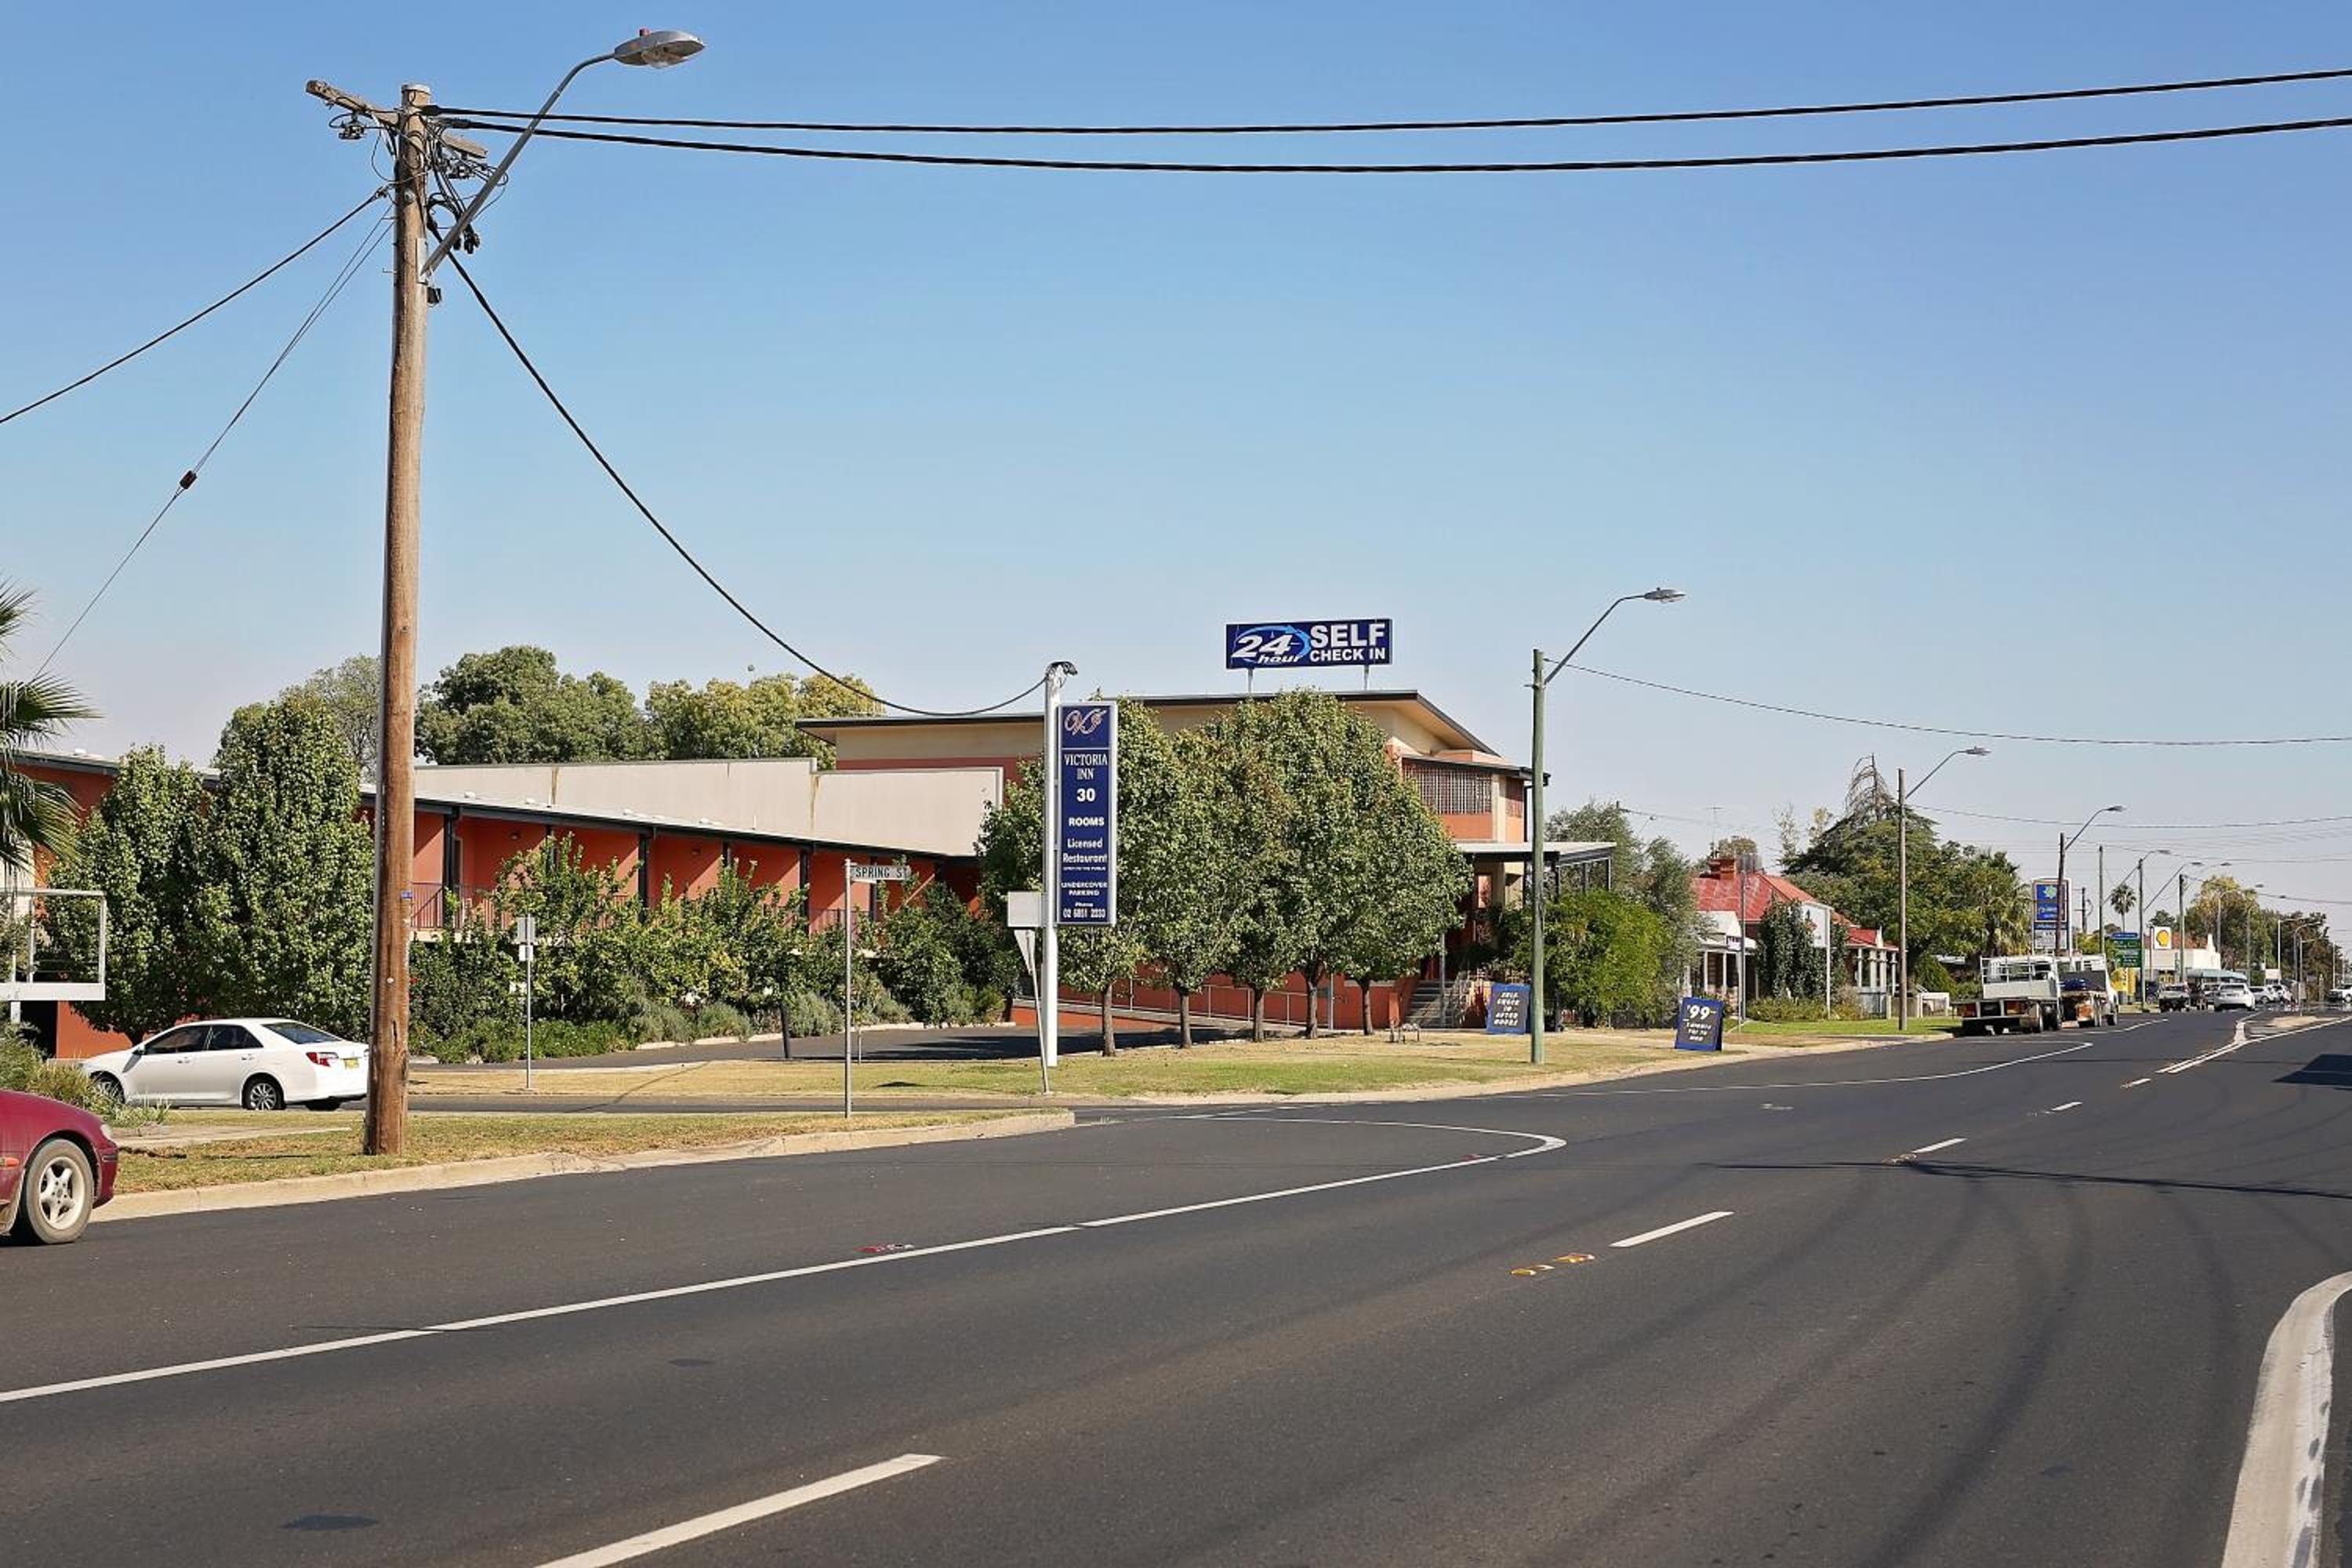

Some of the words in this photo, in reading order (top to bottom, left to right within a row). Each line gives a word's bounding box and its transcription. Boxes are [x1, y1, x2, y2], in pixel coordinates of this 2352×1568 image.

[1310, 623, 1385, 648] SELF
[1230, 634, 1294, 658] 24
[1258, 653, 1304, 664] hour
[1309, 648, 1365, 662] CHECK
[1370, 648, 1385, 659] IN
[1064, 753, 1108, 766] VICTORIA
[1076, 768, 1095, 780] INN
[1076, 788, 1096, 802] 30
[1069, 816, 1105, 827] ROOMS
[1067, 838, 1103, 848] Licensed
[1063, 852, 1107, 863] Restaurant
[855, 866, 890, 878] SPRING
[896, 866, 907, 879] ST
[1062, 908, 1072, 918] 02
